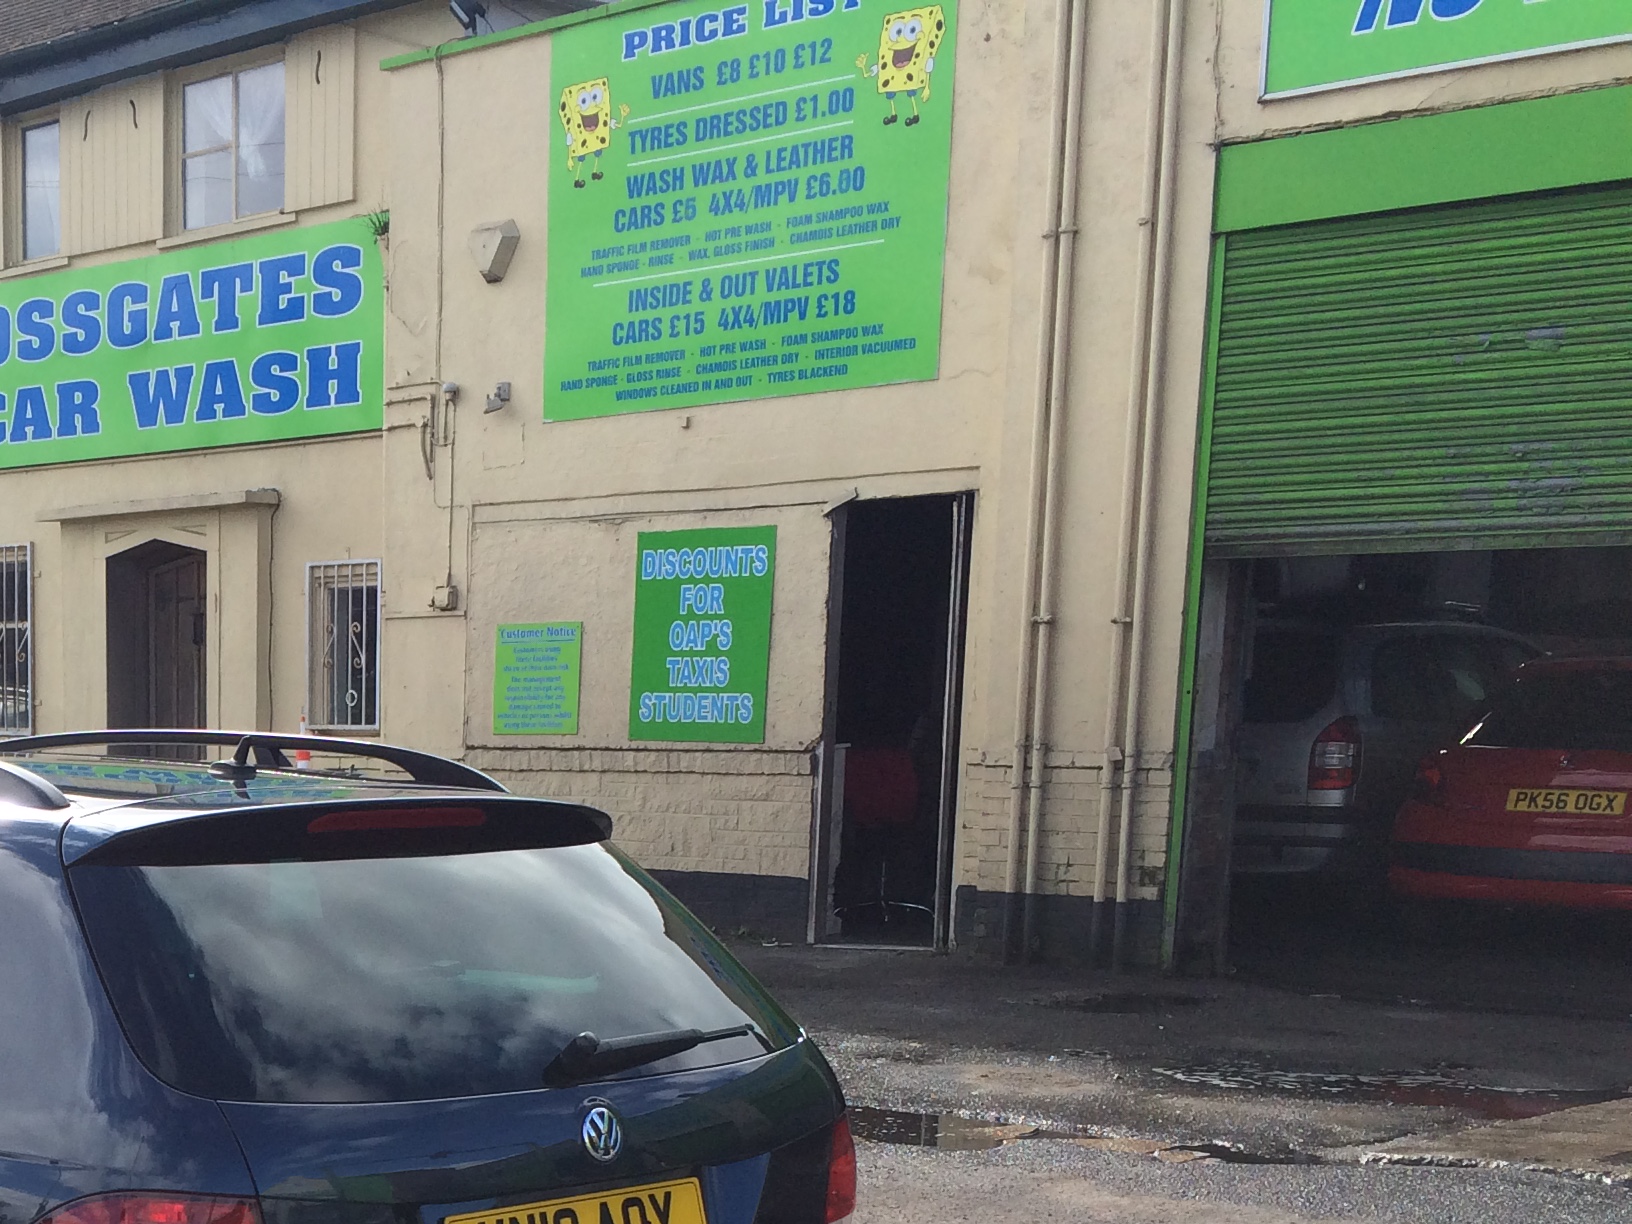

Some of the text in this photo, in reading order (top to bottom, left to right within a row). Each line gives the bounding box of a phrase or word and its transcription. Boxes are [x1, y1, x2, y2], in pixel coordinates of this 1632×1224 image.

[622, 4, 748, 61] PRICE
[651, 38, 833, 99] VANS £8 £10 £12
[628, 87, 854, 154] TYRES DRESSED £1.00
[626, 134, 854, 199] WASH WAX & LEATHER
[614, 166, 865, 233] CARS £5 4X4/MPV £6.00
[580, 264, 604, 278] HAND
[606, 258, 640, 274] SPONGE
[648, 253, 674, 268] RINSE
[713, 241, 742, 257] GLOSS
[744, 236, 775, 252] FINISH
[790, 227, 834, 245] CHAMOIS
[836, 220, 877, 238] LEATHER
[881, 216, 901, 230] DRY
[591, 201, 890, 261] TRAFFIC FILM REMOVER HOT PRE WASH FOAM SHAMPOO WAX
[628, 258, 840, 314] INSIDE & OUT VALETS
[612, 290, 856, 346] CARS £15 4X4/MPV £18
[560, 337, 916, 392] HAND SPONGE GLOSS RINSE CHAMOIS LEATHER DRY INTERIOR VACUUMED
[587, 323, 884, 372] TRAFFIC FILM REMOVER HOT PRE WASH FOAM SHAMPOO WAX
[126, 340, 364, 432] WASH
[615, 363, 848, 402] WINDOWS CLEANED IN AND OUT TYRES BLACKEND
[641, 545, 768, 580] DISCOUNTS
[679, 584, 724, 615] FOR
[500, 626, 576, 639] Customer Notice
[669, 620, 732, 651] OAP'S
[666, 657, 730, 687] TAXIS
[639, 692, 753, 723] STUDENTS
[1513, 791, 1618, 812] PK56 OGX
